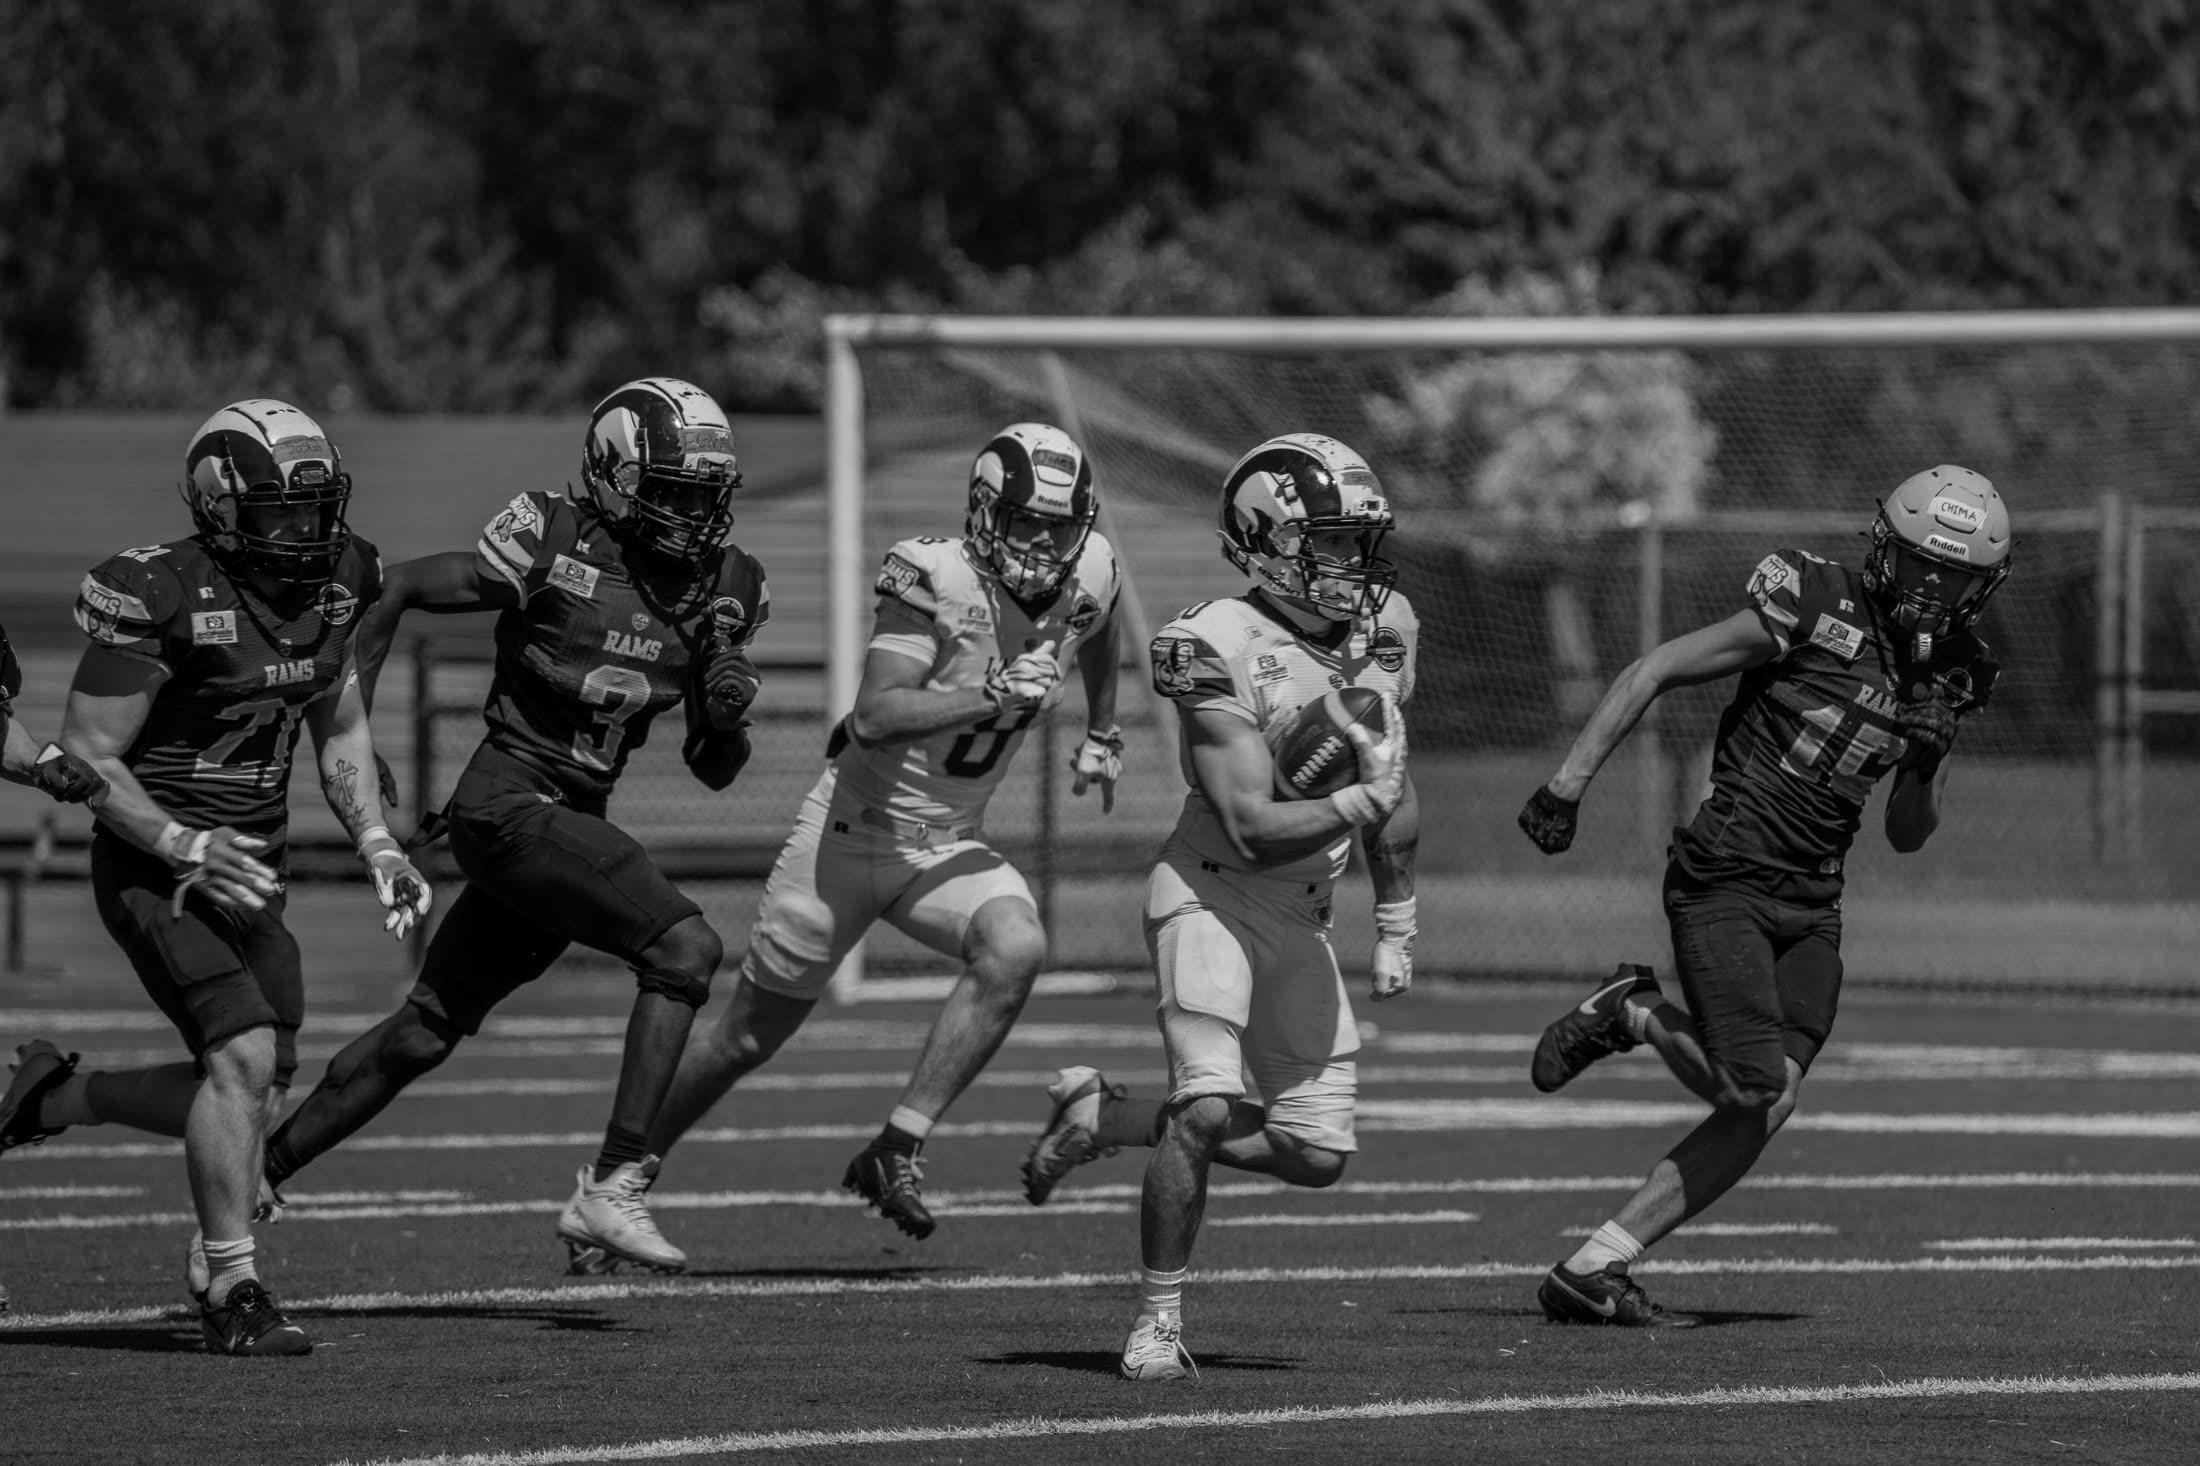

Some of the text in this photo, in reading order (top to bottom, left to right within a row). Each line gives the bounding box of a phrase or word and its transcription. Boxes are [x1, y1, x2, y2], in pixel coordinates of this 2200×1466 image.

[1941, 502, 1977, 521] CHIMA
[1930, 537, 1967, 555] Riddell
[602, 629, 663, 662] RAMS
[264, 658, 315, 687] RAMS
[571, 664, 652, 773] 3
[192, 697, 305, 788] 21
